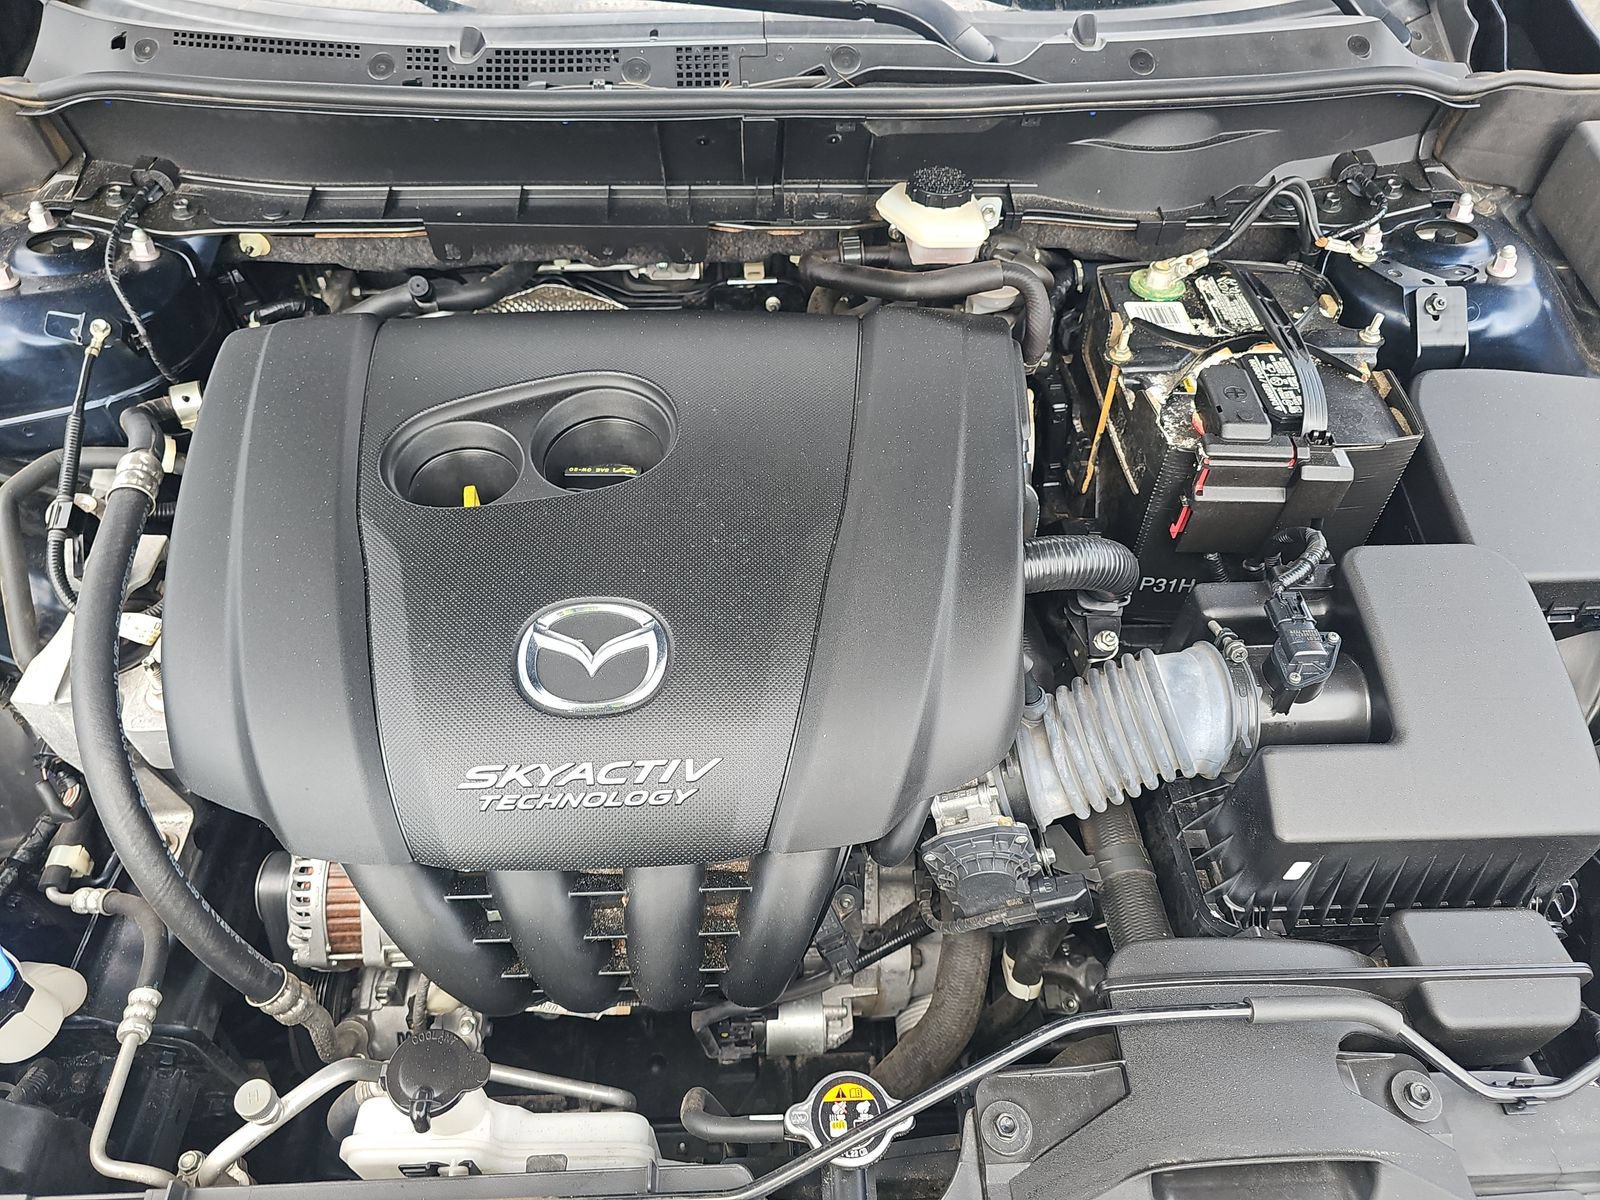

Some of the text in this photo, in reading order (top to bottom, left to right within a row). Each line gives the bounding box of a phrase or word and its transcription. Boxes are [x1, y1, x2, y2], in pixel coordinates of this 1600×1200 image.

[1139, 576, 1196, 594] P31H
[457, 758, 724, 790] SKYACTIV
[479, 788, 700, 812] TECHNOLOGY
[411, 1030, 459, 1046] COOLANT
